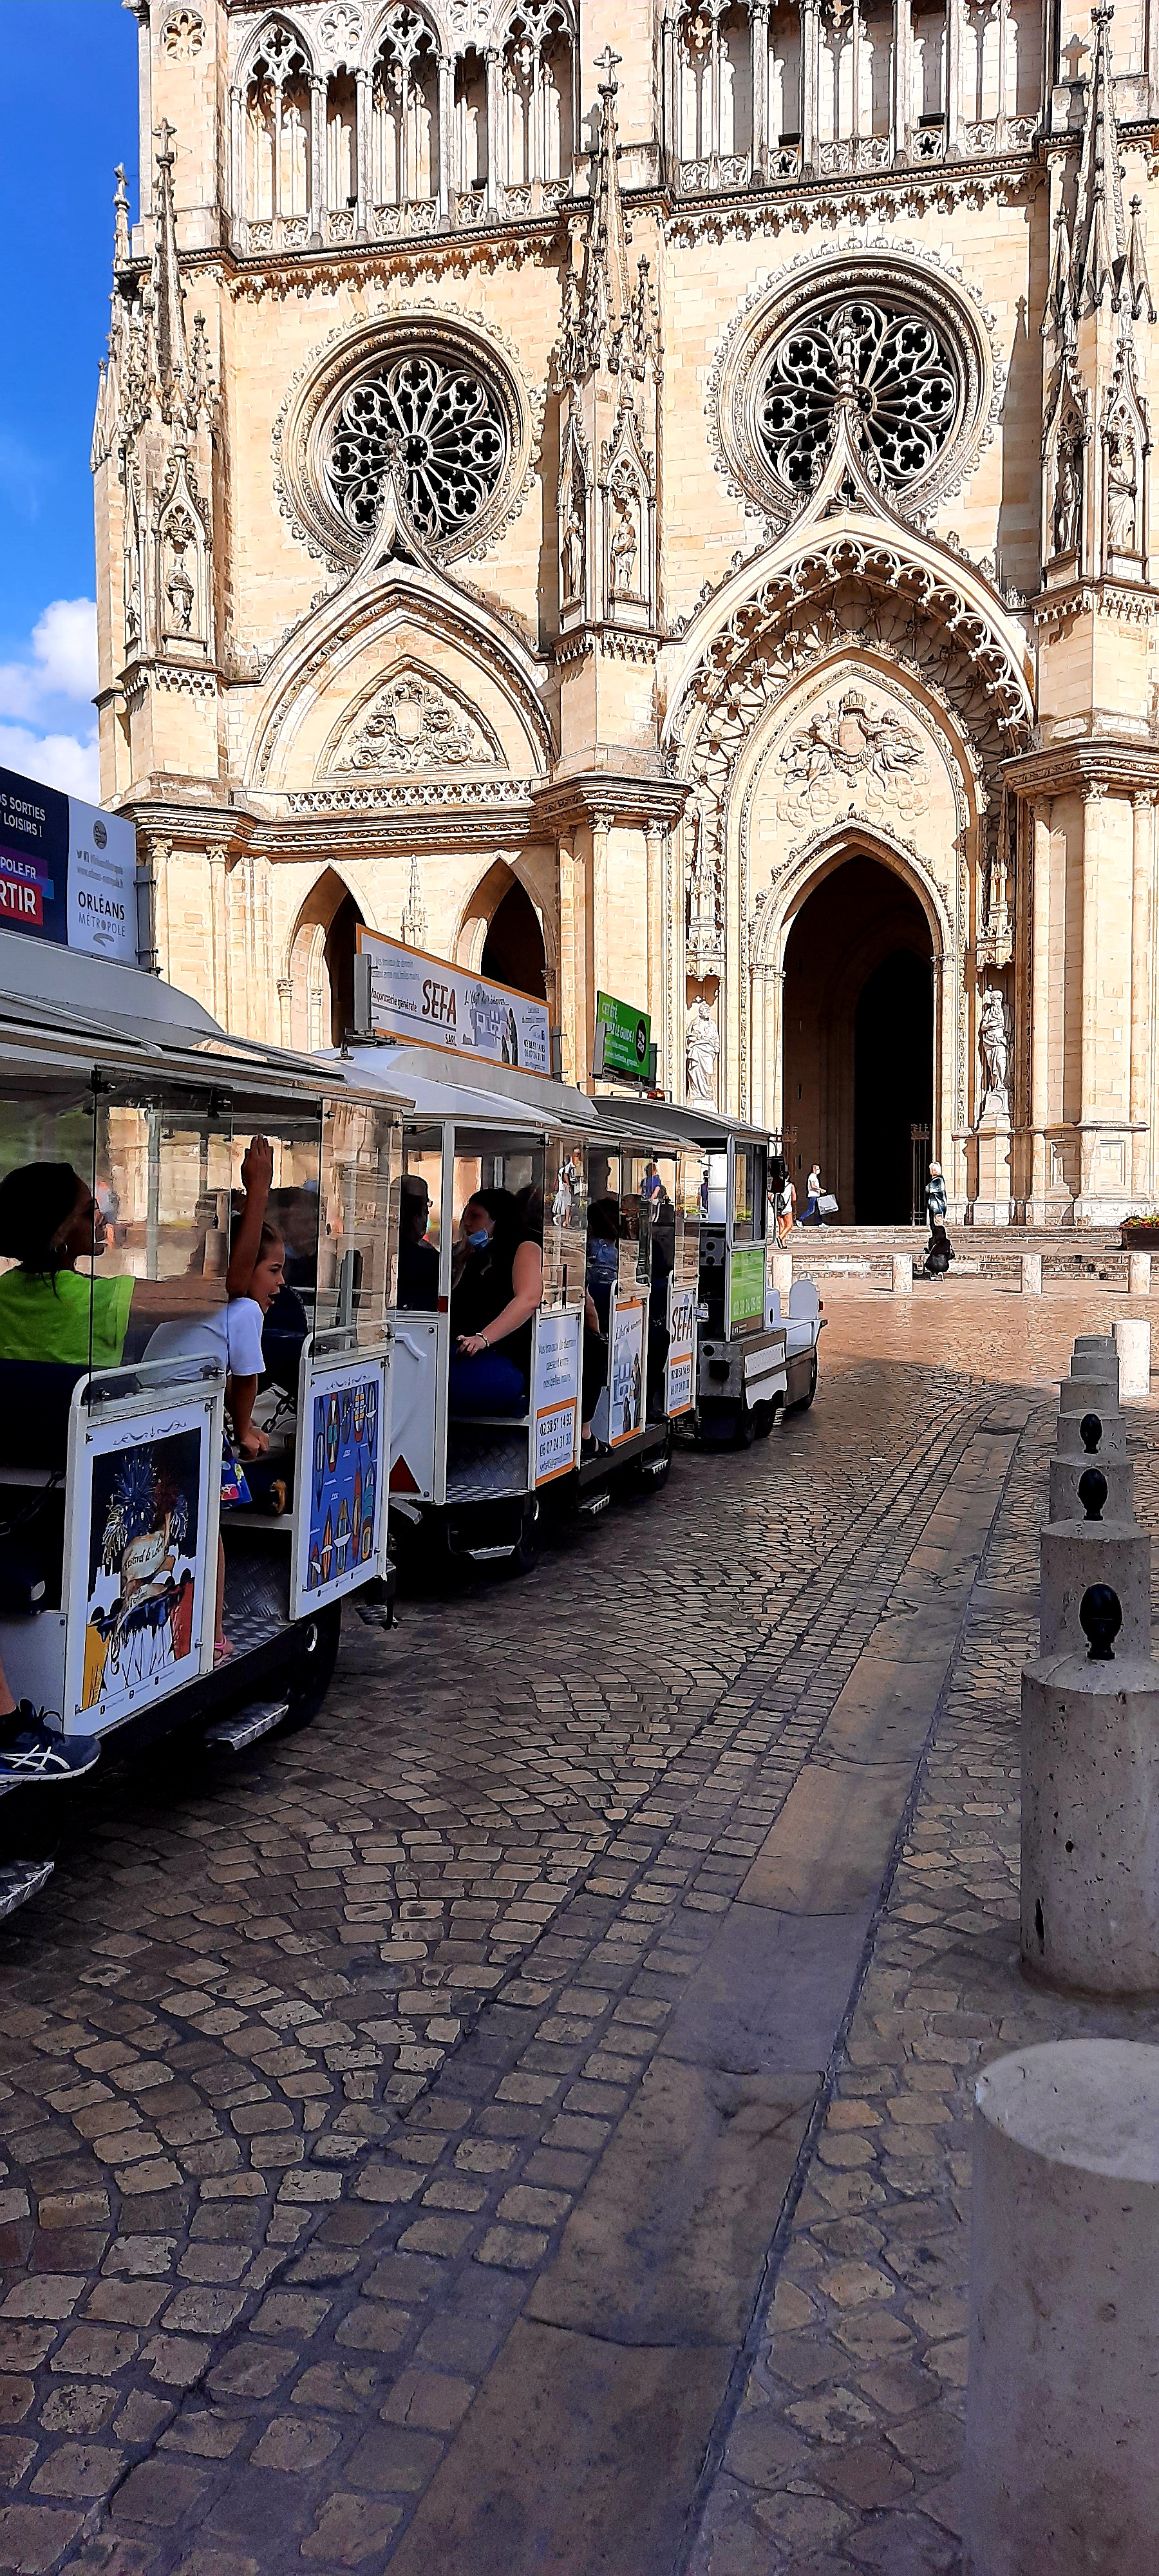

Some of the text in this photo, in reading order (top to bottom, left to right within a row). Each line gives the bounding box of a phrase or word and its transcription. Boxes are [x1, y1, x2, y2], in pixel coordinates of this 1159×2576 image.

[10, 797, 46, 821] SORTIES
[4, 812, 37, 836] LOISIRS
[78, 891, 125, 920] ORLÉANS
[79, 912, 126, 937] MÉTROPOLE
[422, 979, 457, 1025] SEFA
[615, 1025, 620, 1037] LE
[620, 1027, 632, 1042] GUIDE
[671, 1304, 693, 1344] SEFA
